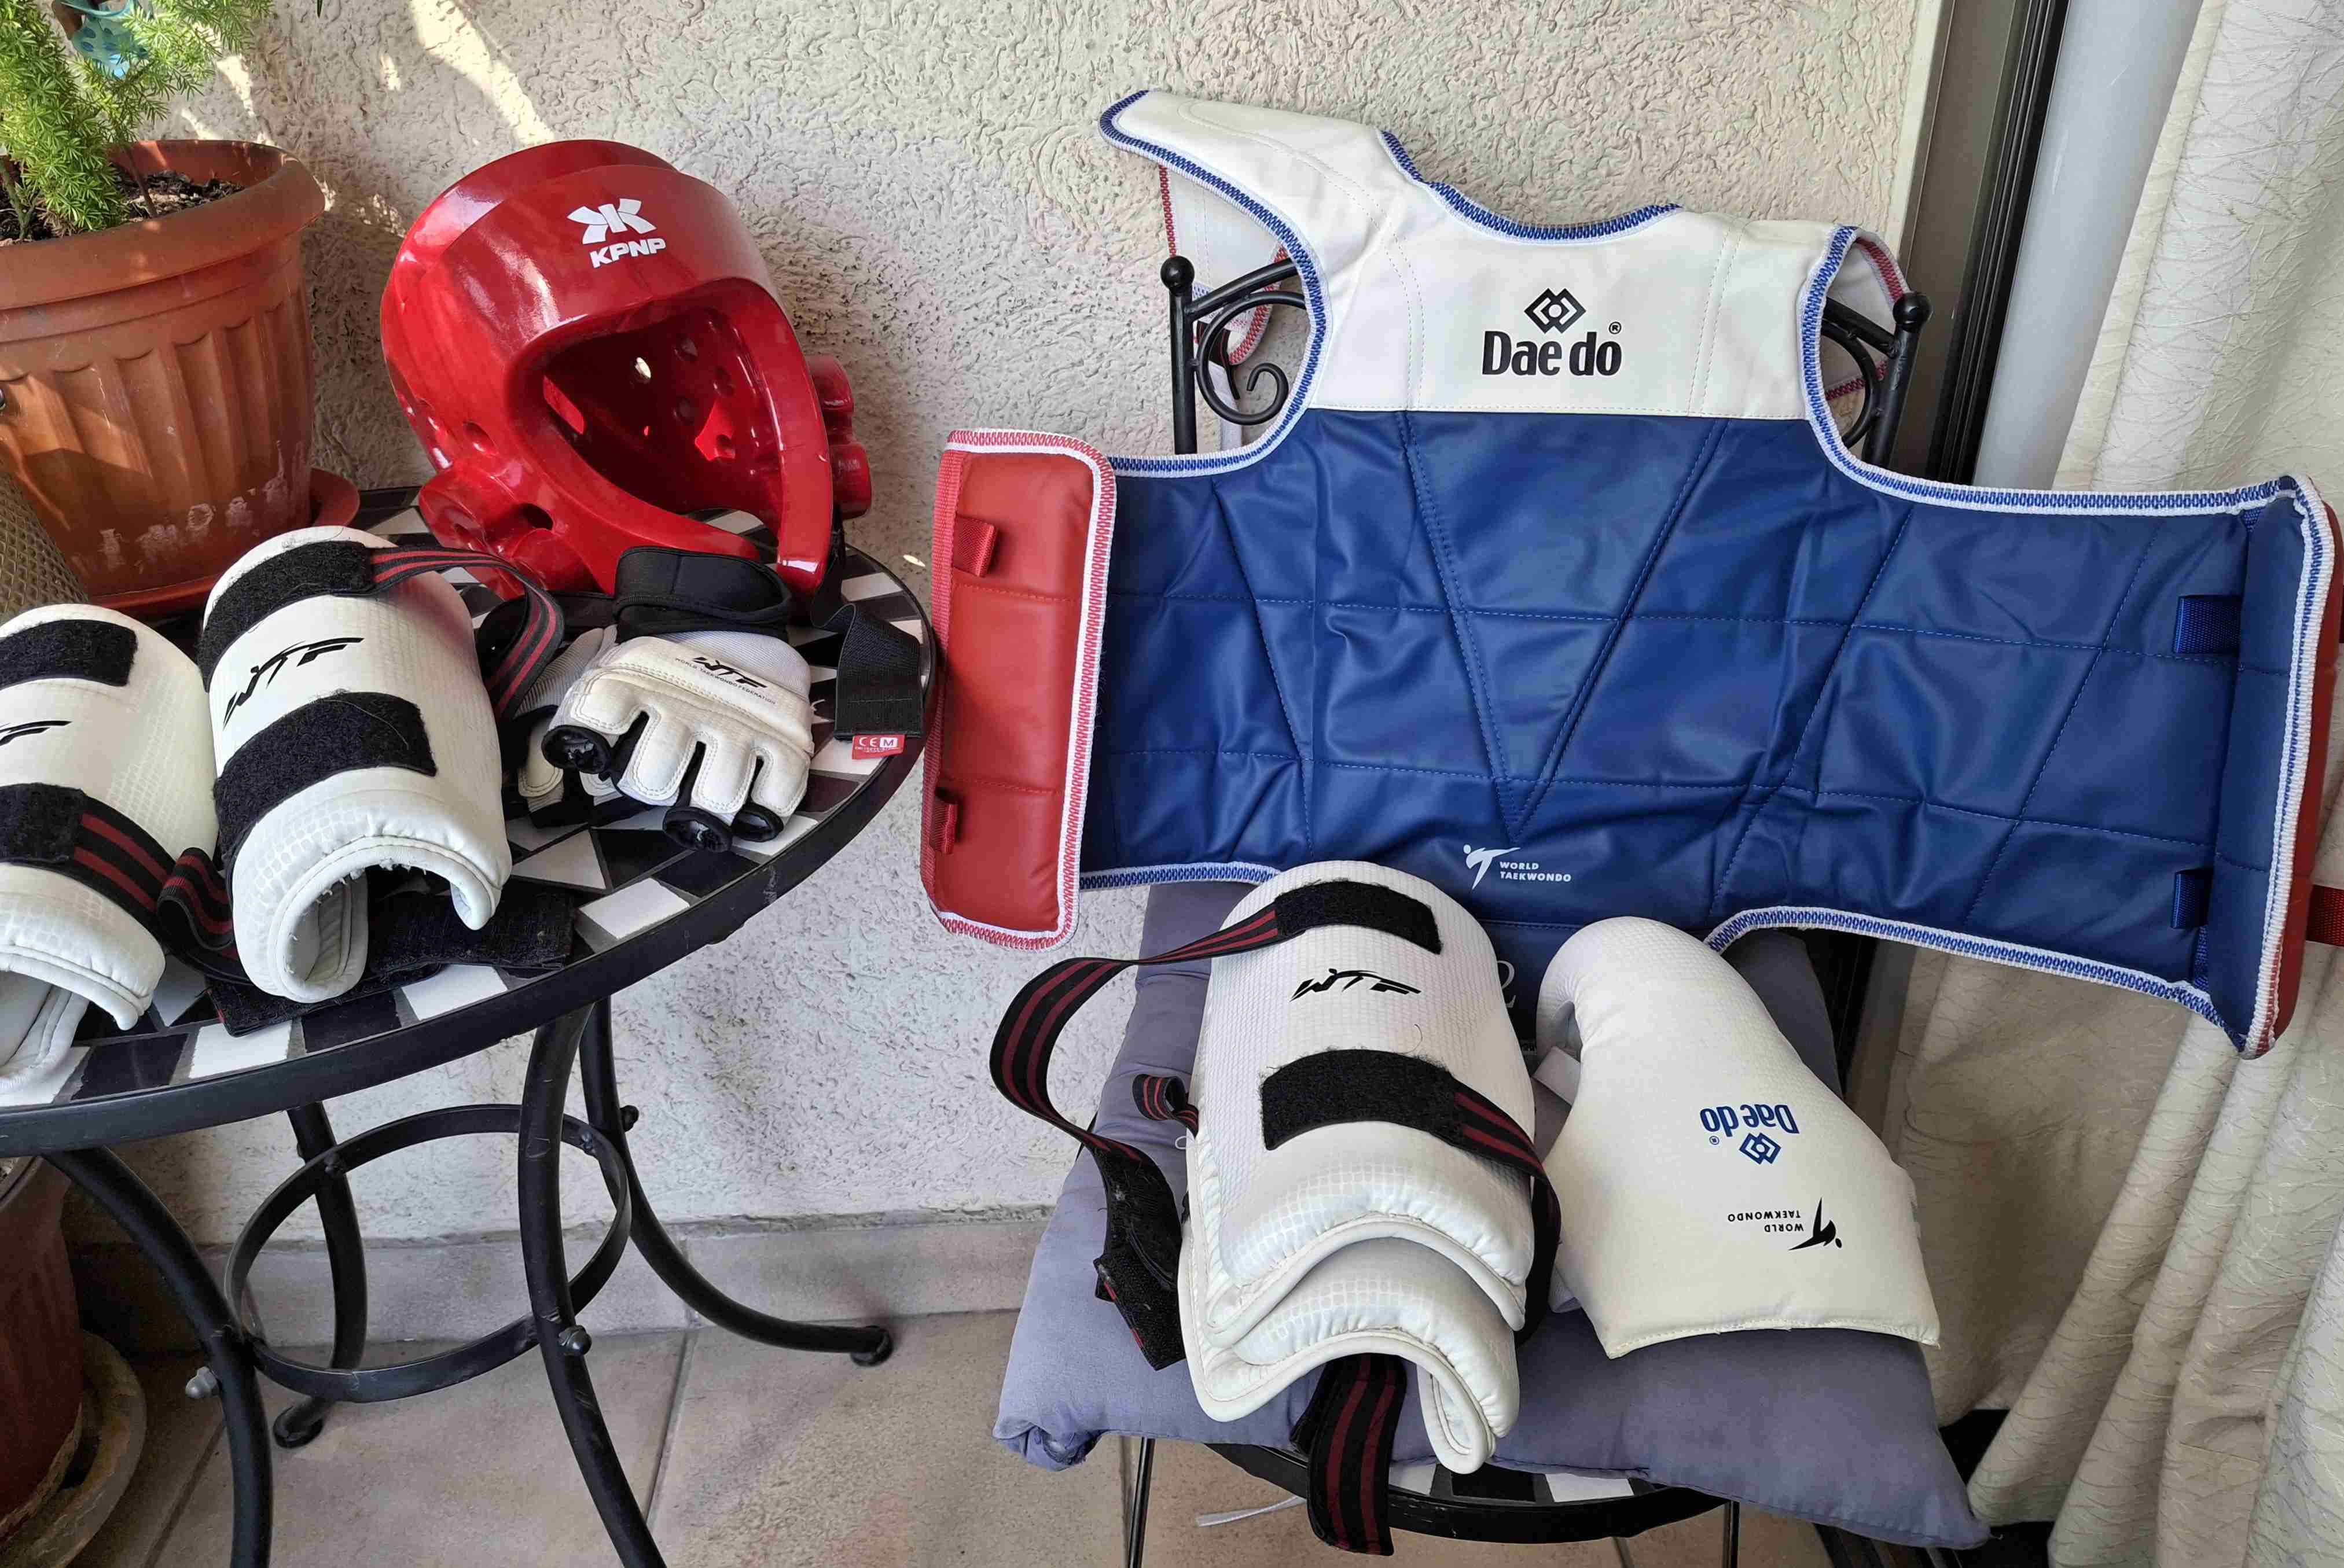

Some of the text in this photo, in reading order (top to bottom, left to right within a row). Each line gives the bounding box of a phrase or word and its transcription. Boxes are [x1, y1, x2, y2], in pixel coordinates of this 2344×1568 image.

[589, 238, 666, 268] KPNP
[675, 657, 776, 705] WORLD TAEKWONDO FEDERATION
[1500, 862, 1539, 870] WORLD
[1500, 871, 1572, 882] TAEKWONDO
[1728, 1210, 1801, 1222] TAEKWONDO
[1763, 1223, 1804, 1232] WORLD
